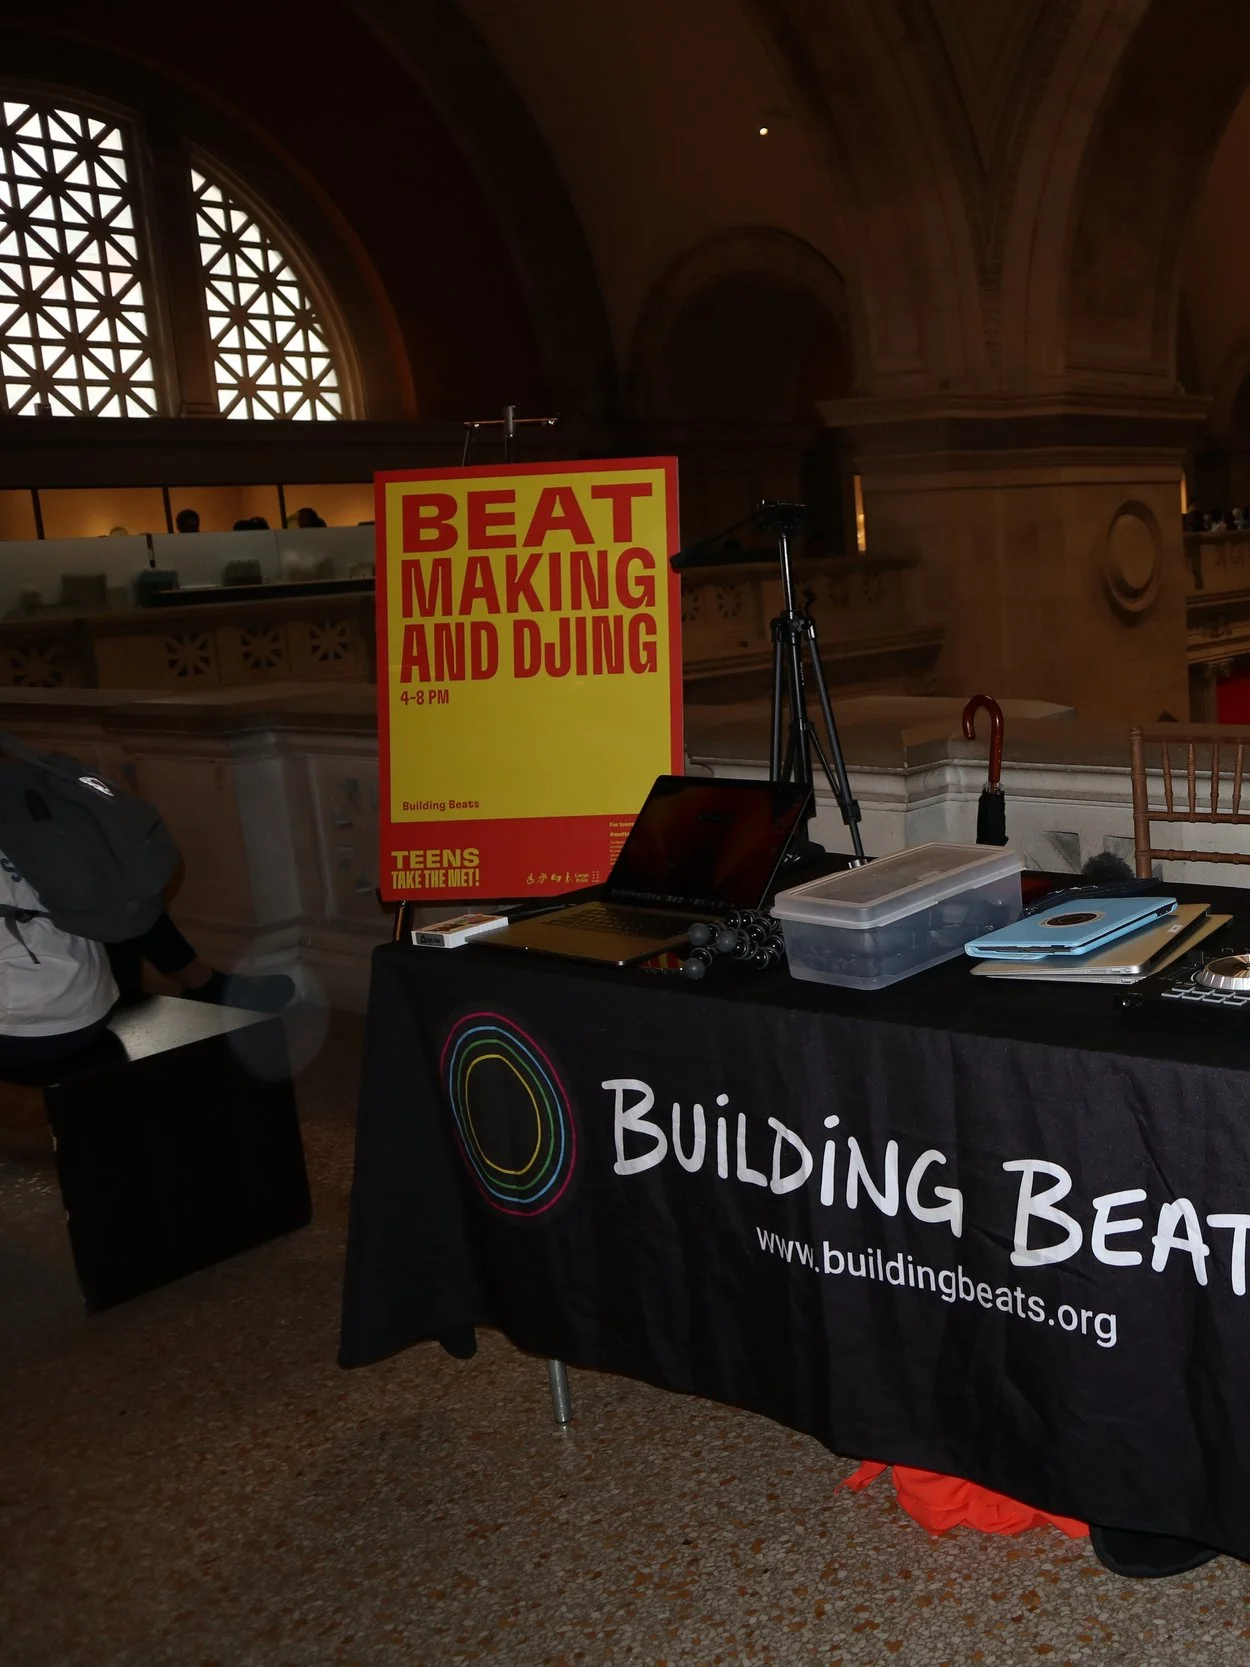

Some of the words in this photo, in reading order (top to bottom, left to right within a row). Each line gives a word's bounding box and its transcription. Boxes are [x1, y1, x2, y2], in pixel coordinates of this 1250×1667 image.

[402, 482, 653, 554] BEAT
[401, 547, 656, 618] MAKING
[400, 621, 499, 683] AND
[513, 613, 658, 678] DJING
[428, 689, 450, 704] PM
[402, 801, 446, 812] Building
[448, 800, 480, 809] Beats
[391, 847, 480, 870] TEENS
[391, 870, 422, 889] TAKE
[423, 869, 446, 888] THE
[448, 868, 480, 888] MET!
[755, 1224, 1119, 1348] www.buildingbeats.org
